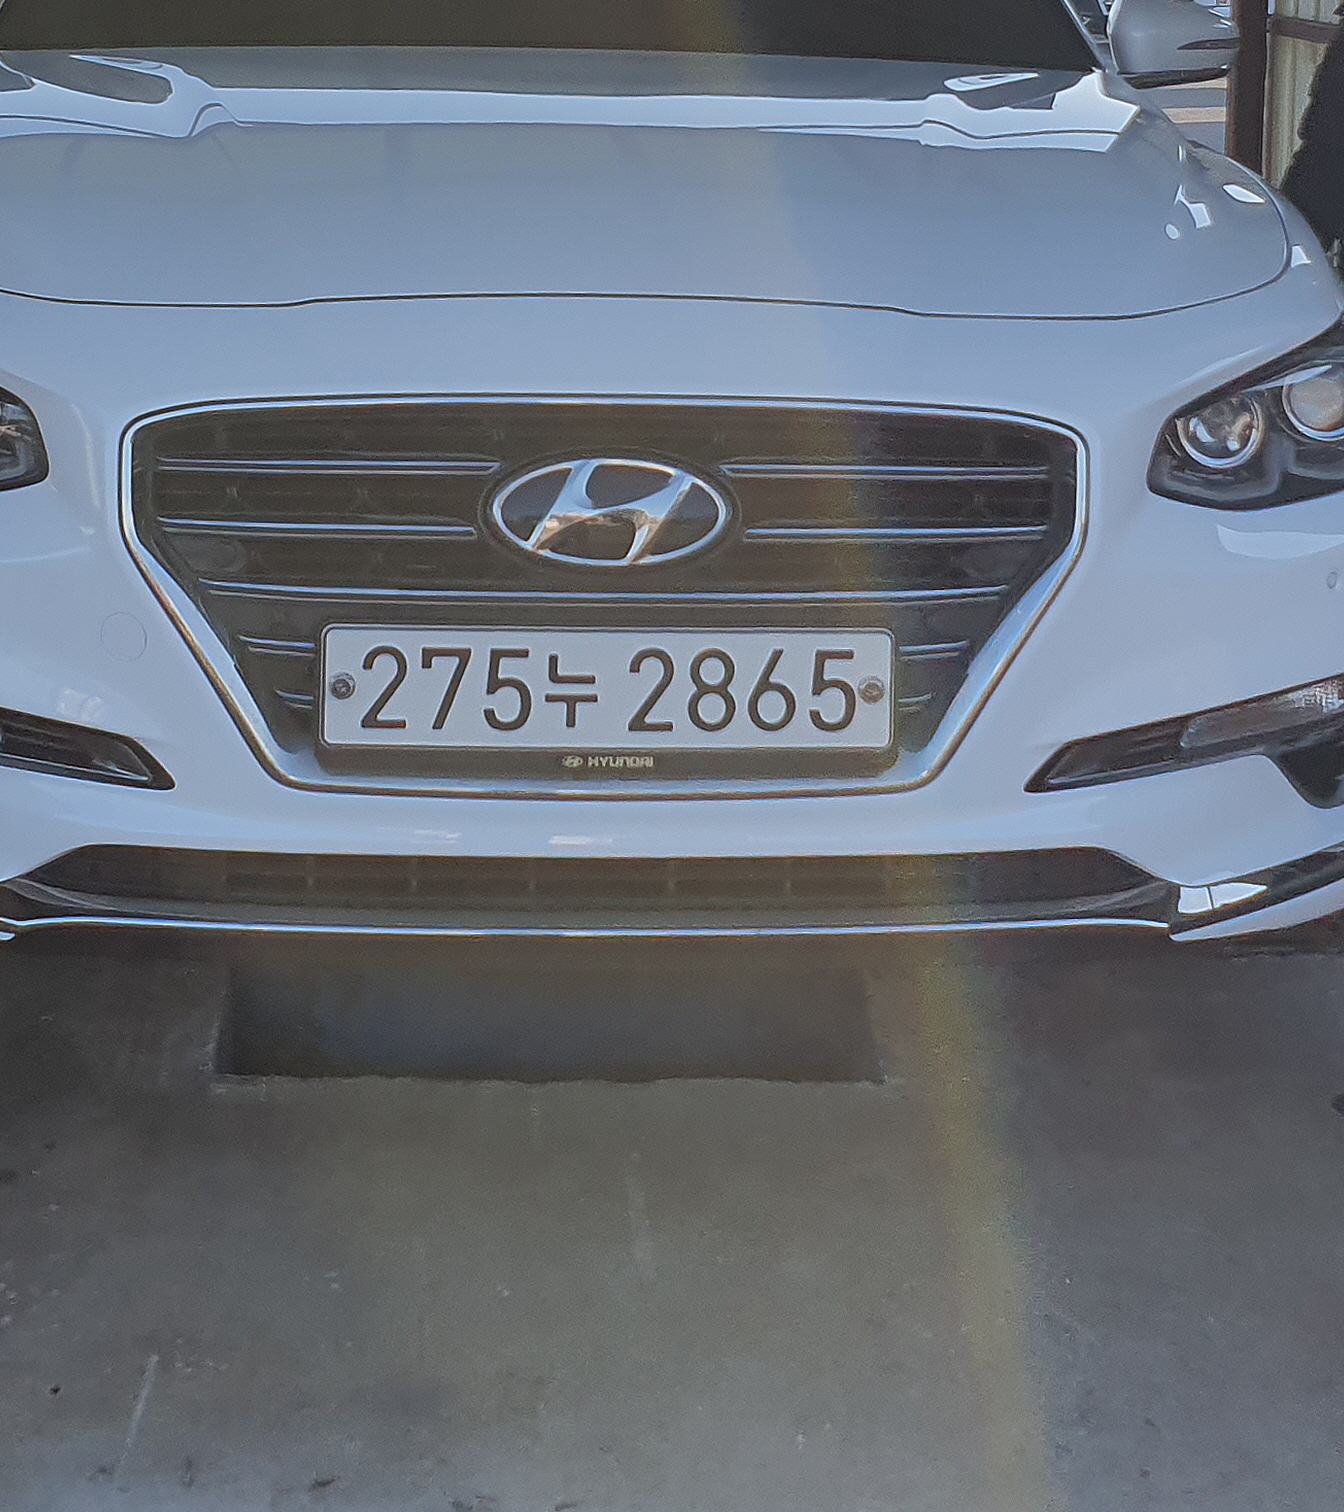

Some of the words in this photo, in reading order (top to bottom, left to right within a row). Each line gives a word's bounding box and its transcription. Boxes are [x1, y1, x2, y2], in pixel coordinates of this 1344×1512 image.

[360, 645, 599, 732] 275누
[627, 647, 857, 733] 2865
[587, 755, 655, 768] HYUNDAI
